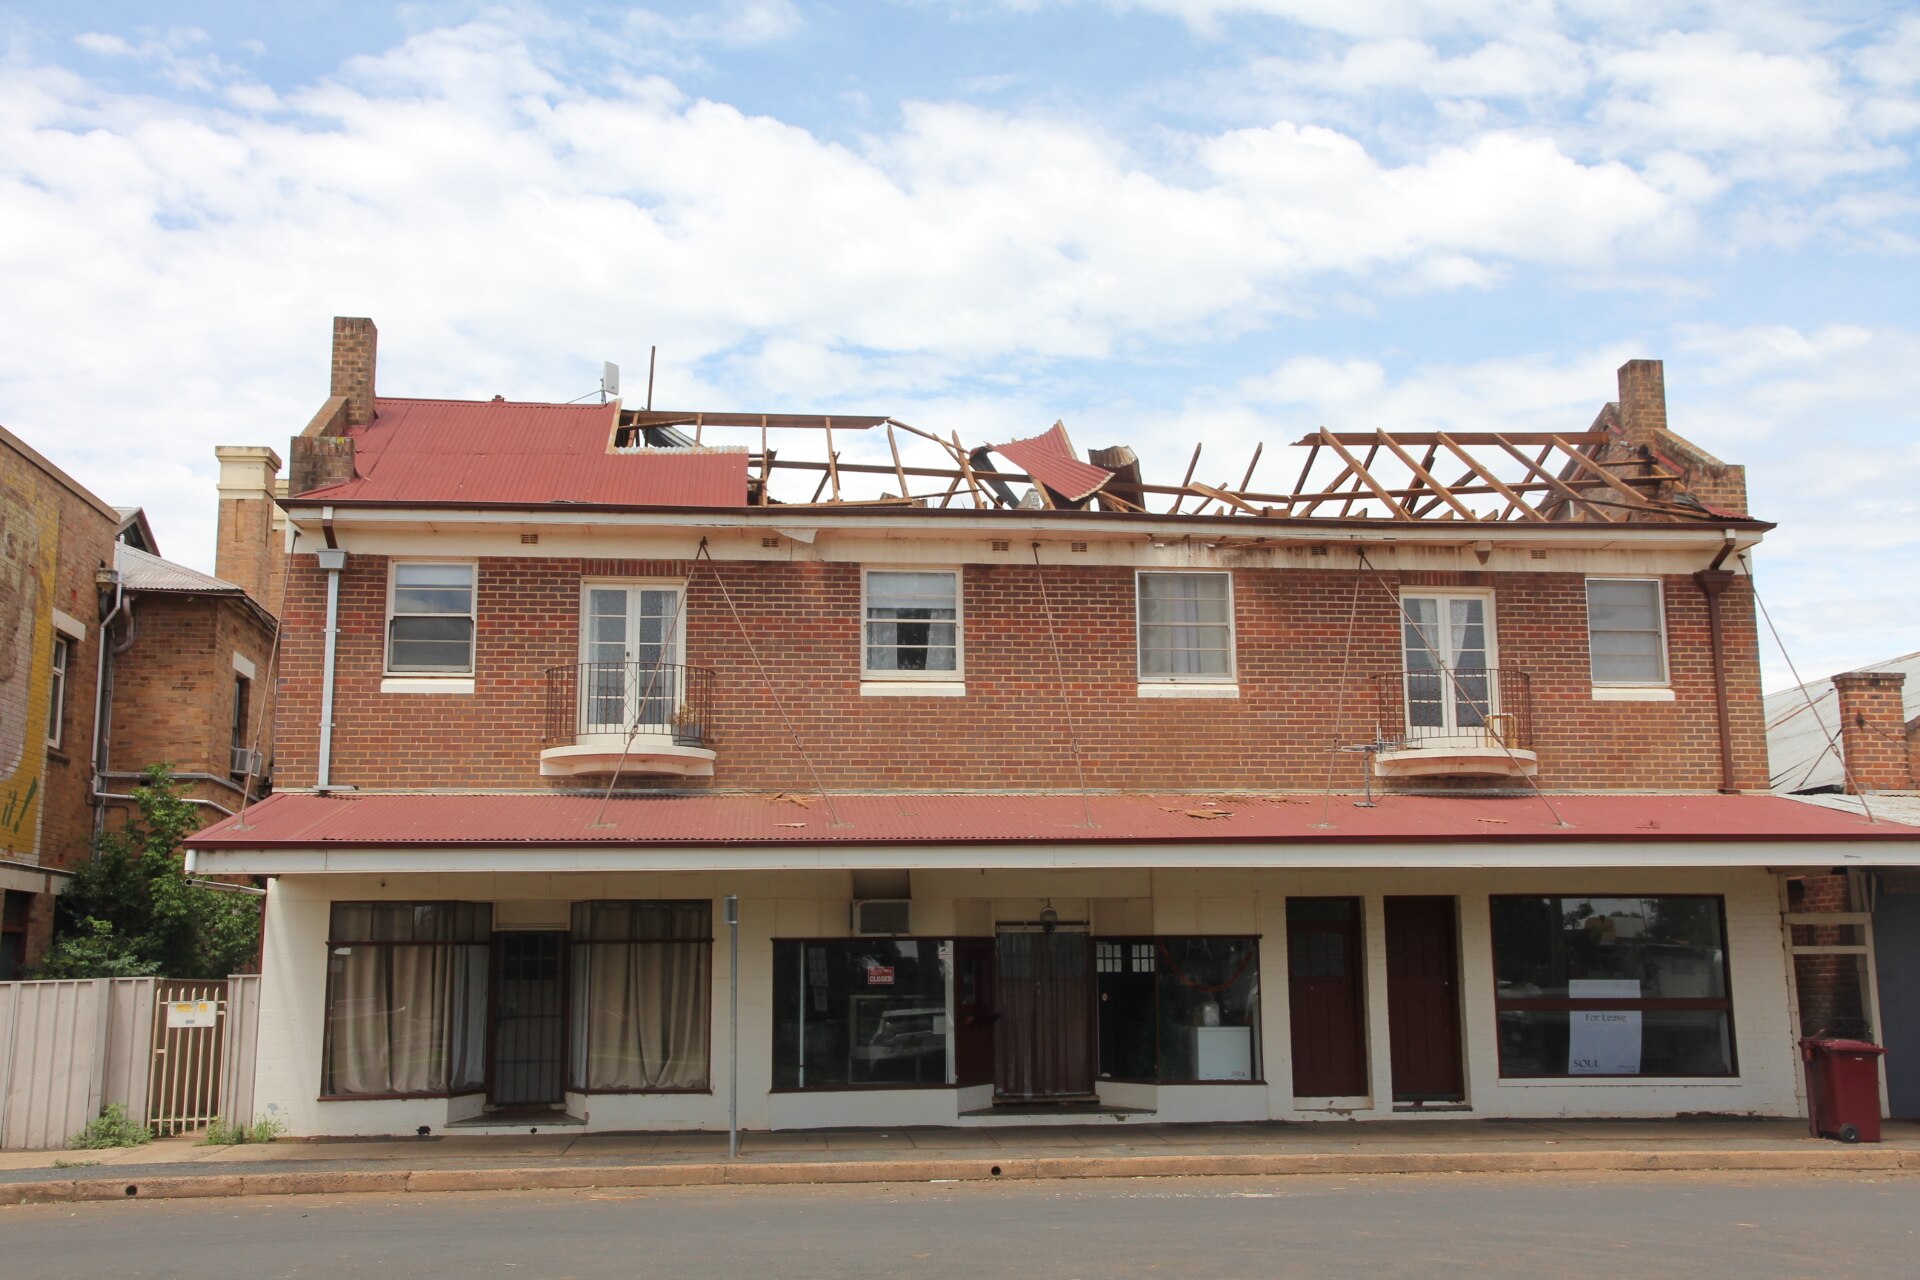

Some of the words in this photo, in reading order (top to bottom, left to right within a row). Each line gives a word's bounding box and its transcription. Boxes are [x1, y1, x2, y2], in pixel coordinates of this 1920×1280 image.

[869, 975, 893, 983] CLOSED
[1585, 1013, 1600, 1022] For
[1602, 1013, 1627, 1022] Lease
[1573, 1059, 1600, 1068] SOUL
